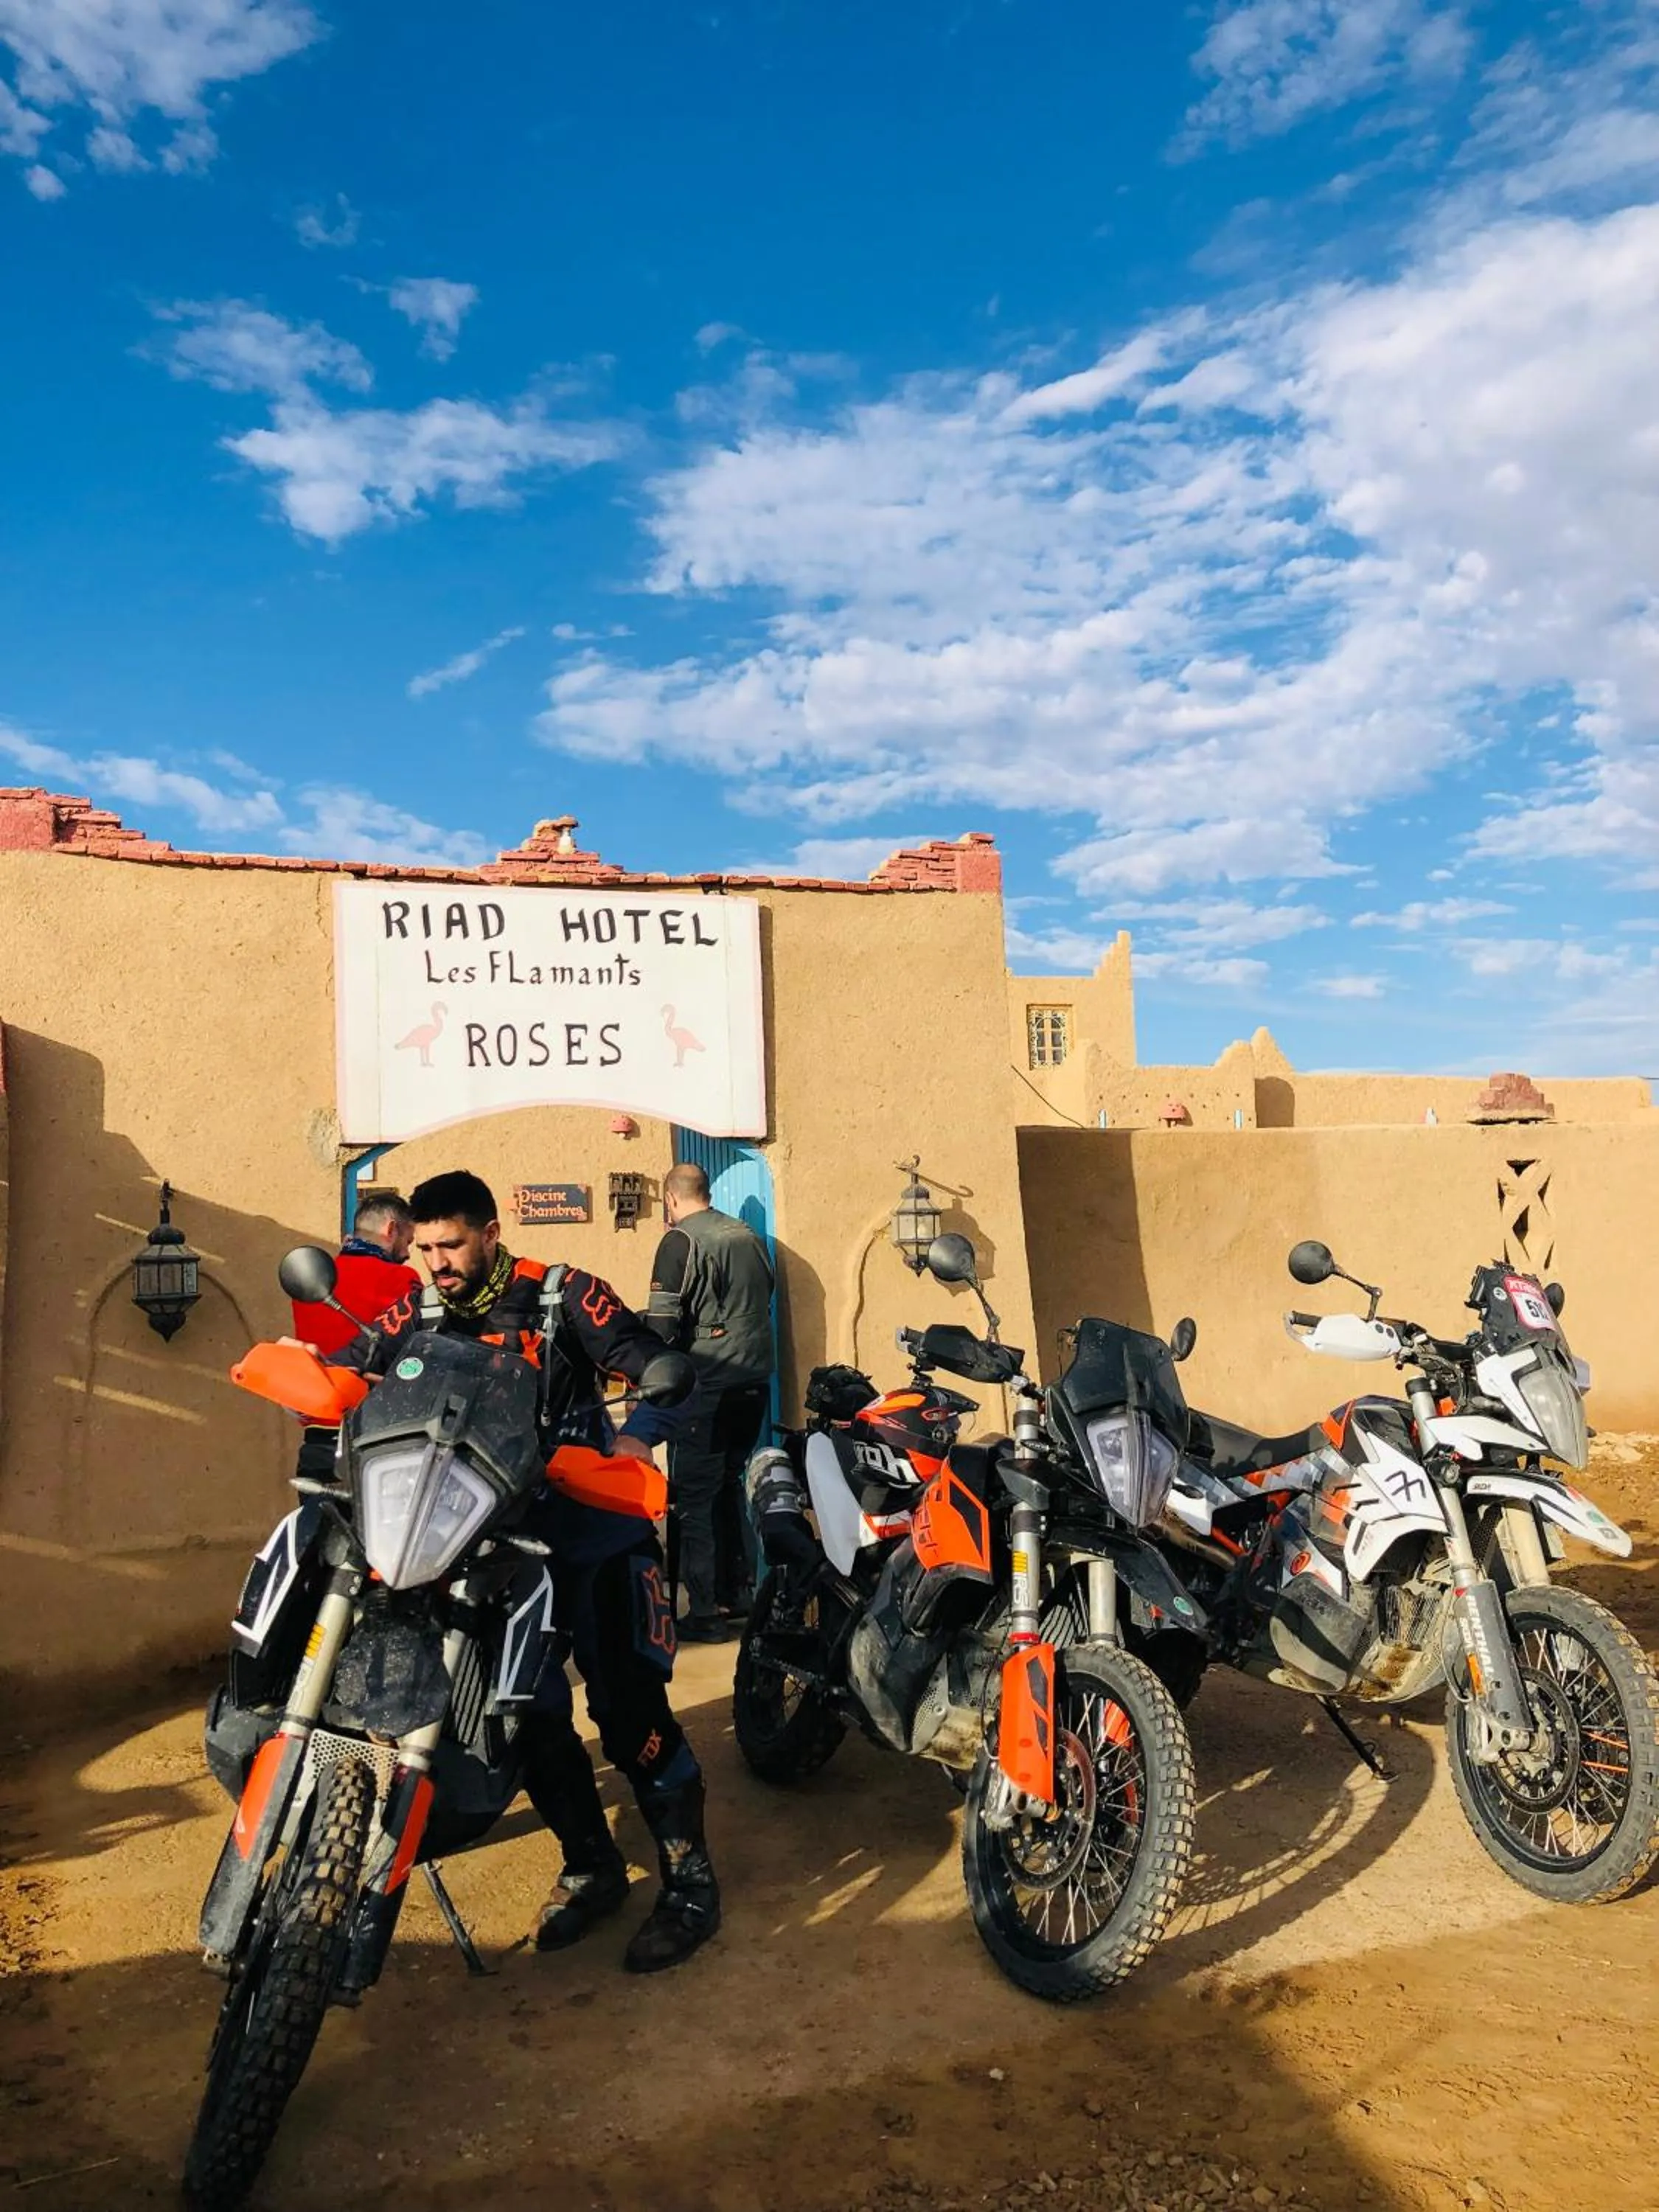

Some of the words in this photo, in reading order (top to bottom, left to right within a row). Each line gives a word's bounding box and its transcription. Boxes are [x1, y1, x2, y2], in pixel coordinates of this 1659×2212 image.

[382, 900, 506, 941] RIAD
[560, 907, 718, 947] HOTEL
[425, 950, 477, 984] Les
[465, 1022, 622, 1068] ROSES
